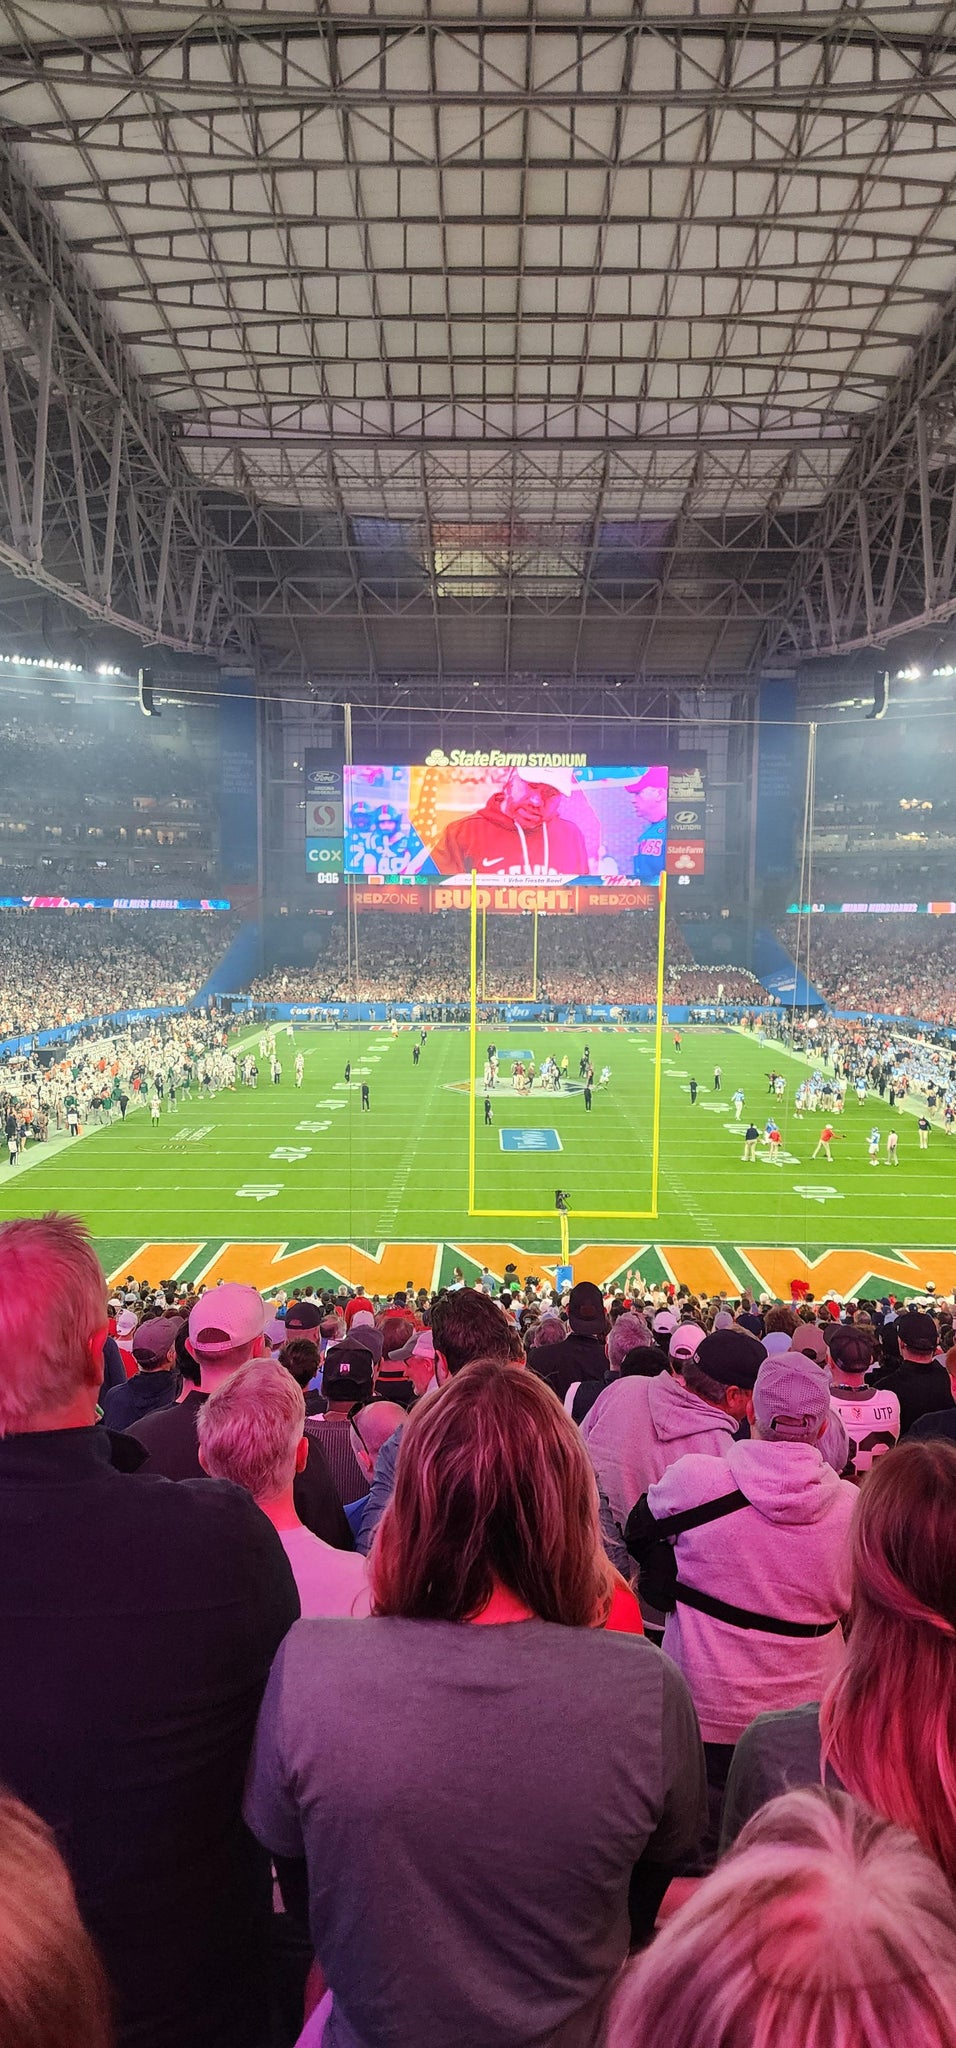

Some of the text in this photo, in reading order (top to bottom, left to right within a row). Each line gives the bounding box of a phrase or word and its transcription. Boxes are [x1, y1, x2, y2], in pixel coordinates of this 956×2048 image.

[528, 753, 587, 767] STADIUM
[314, 772, 334, 782] Ford
[308, 849, 342, 861] COX
[317, 873, 339, 884] 0:06
[353, 893, 418, 905] REDZONE
[435, 889, 572, 909] BUD LIGHT
[589, 894, 655, 906] REDZONE
[873, 1406, 893, 1420] UTP
